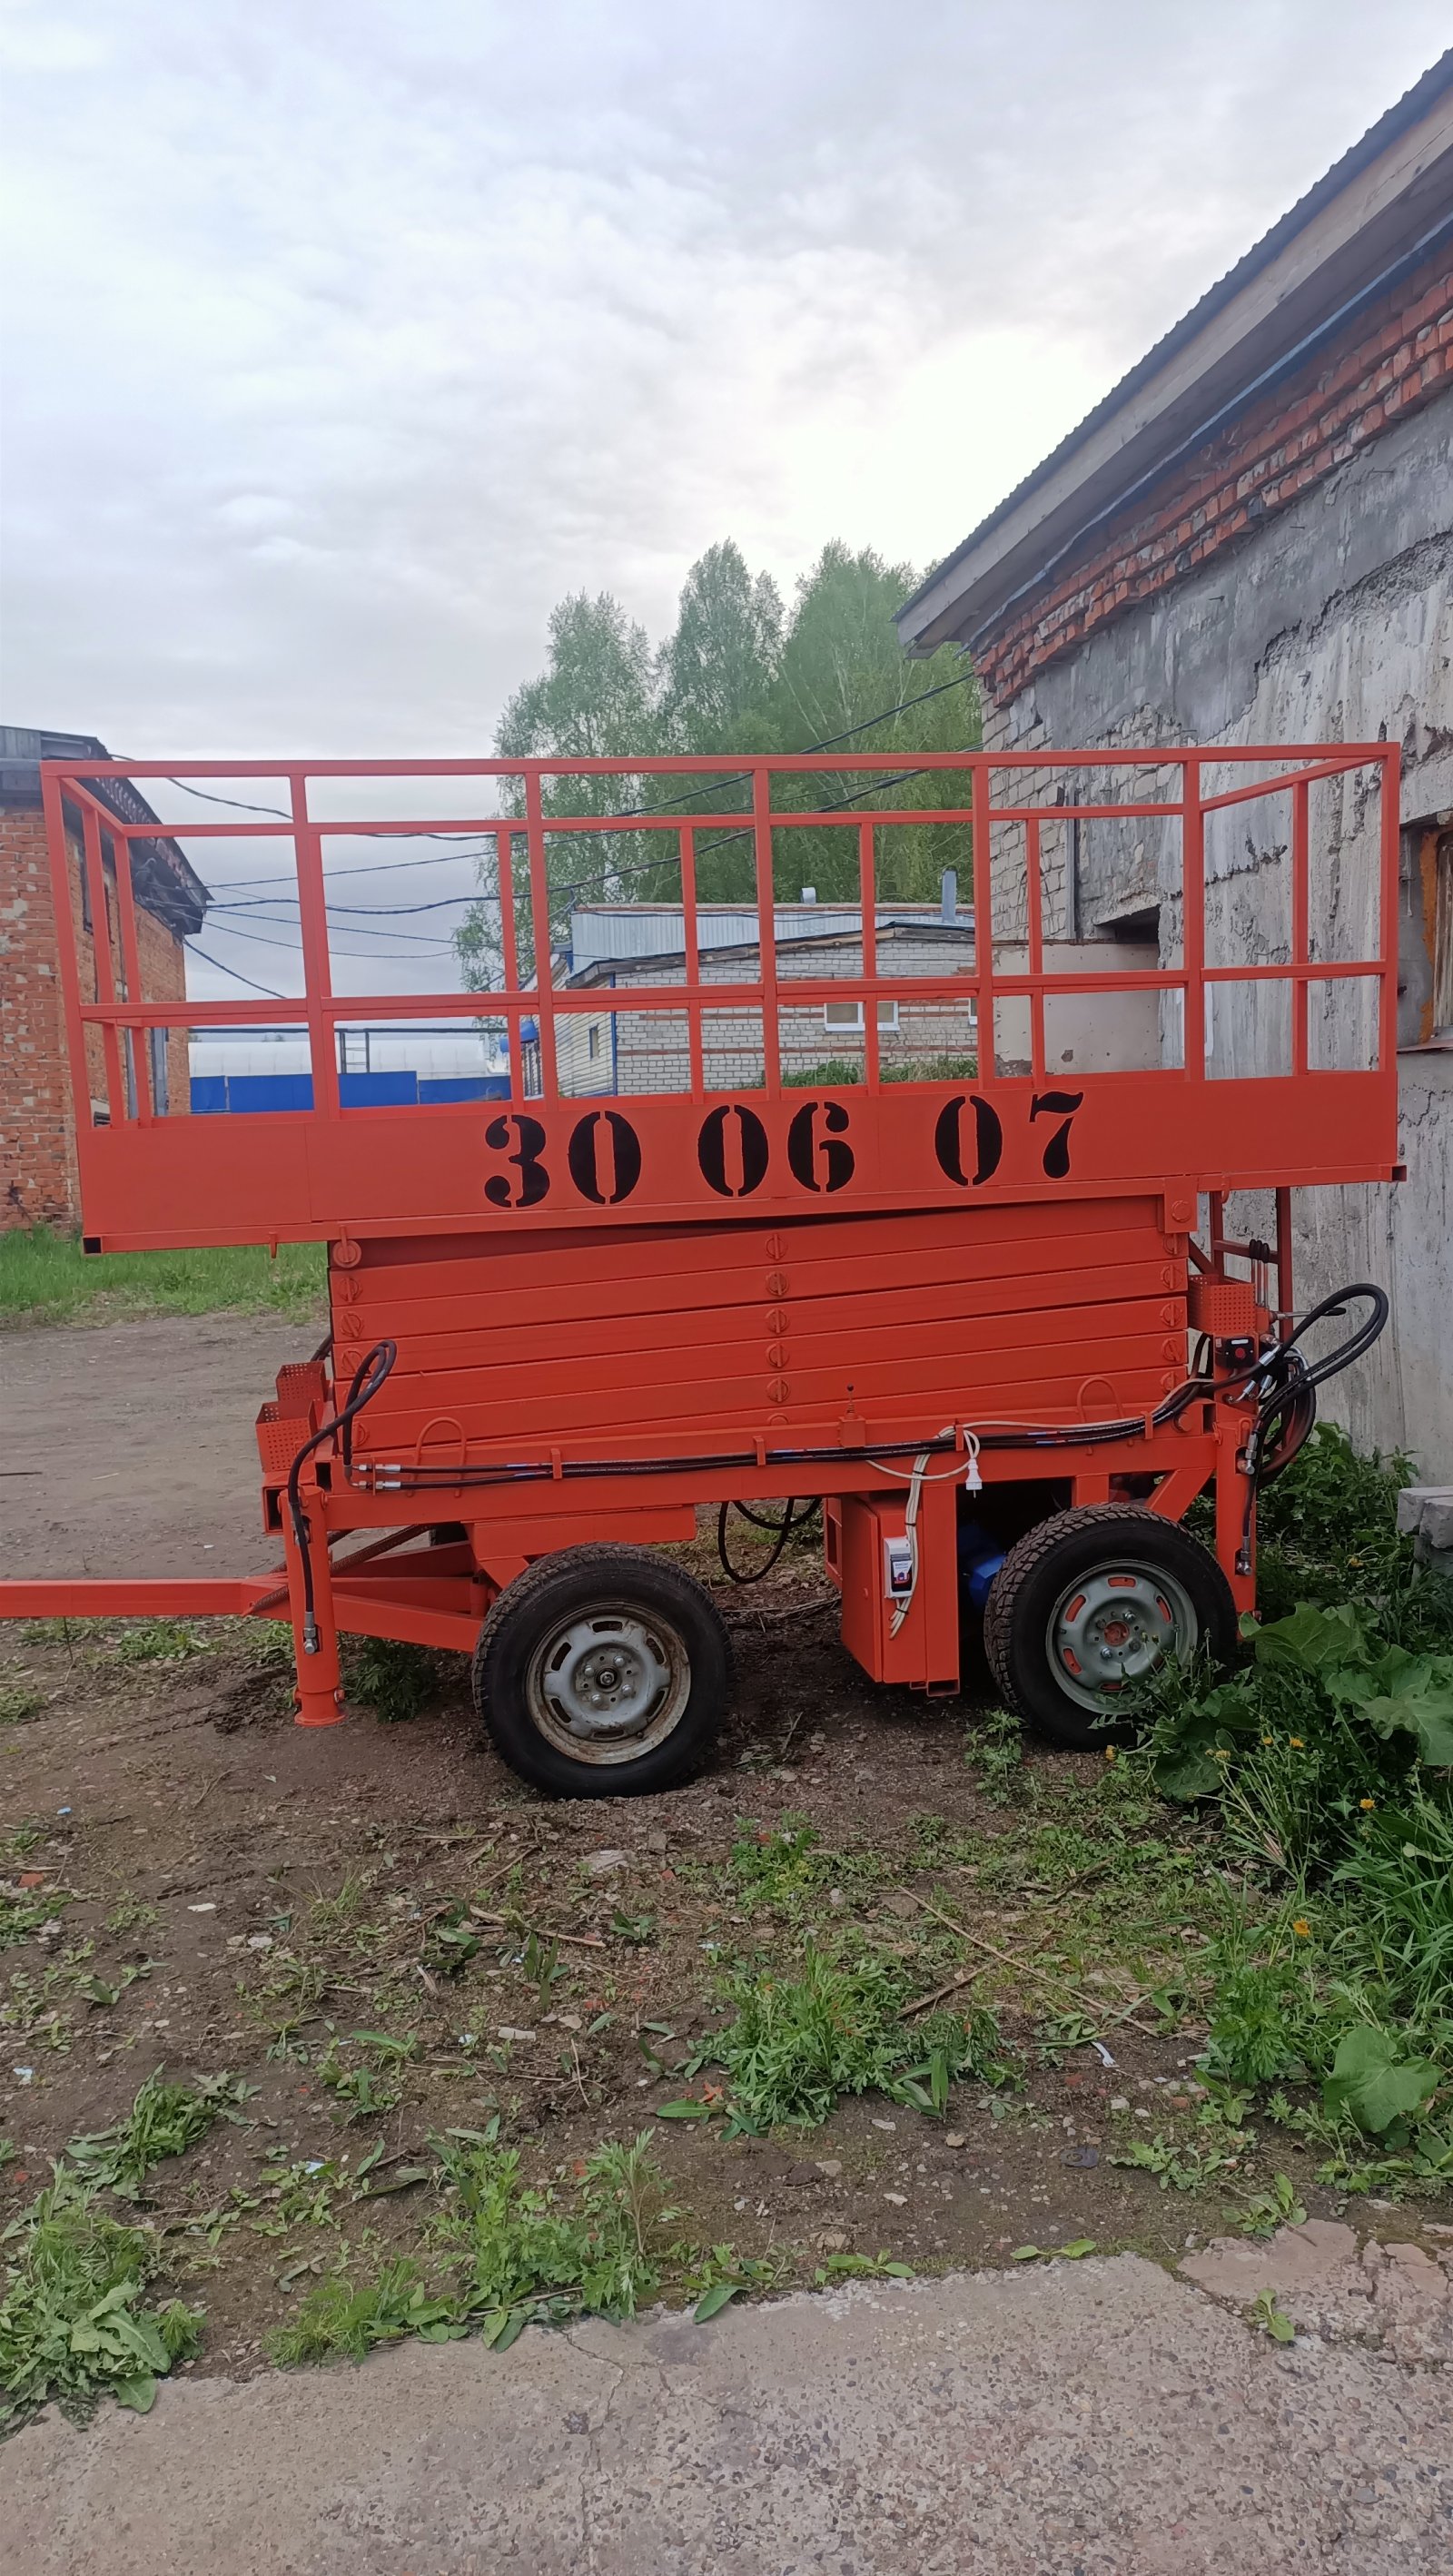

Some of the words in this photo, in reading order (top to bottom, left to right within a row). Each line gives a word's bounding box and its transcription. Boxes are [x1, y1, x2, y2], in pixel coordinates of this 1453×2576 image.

[485, 1111, 641, 1208] 30
[697, 1102, 855, 1197] 06
[935, 1091, 1083, 1186] 07
